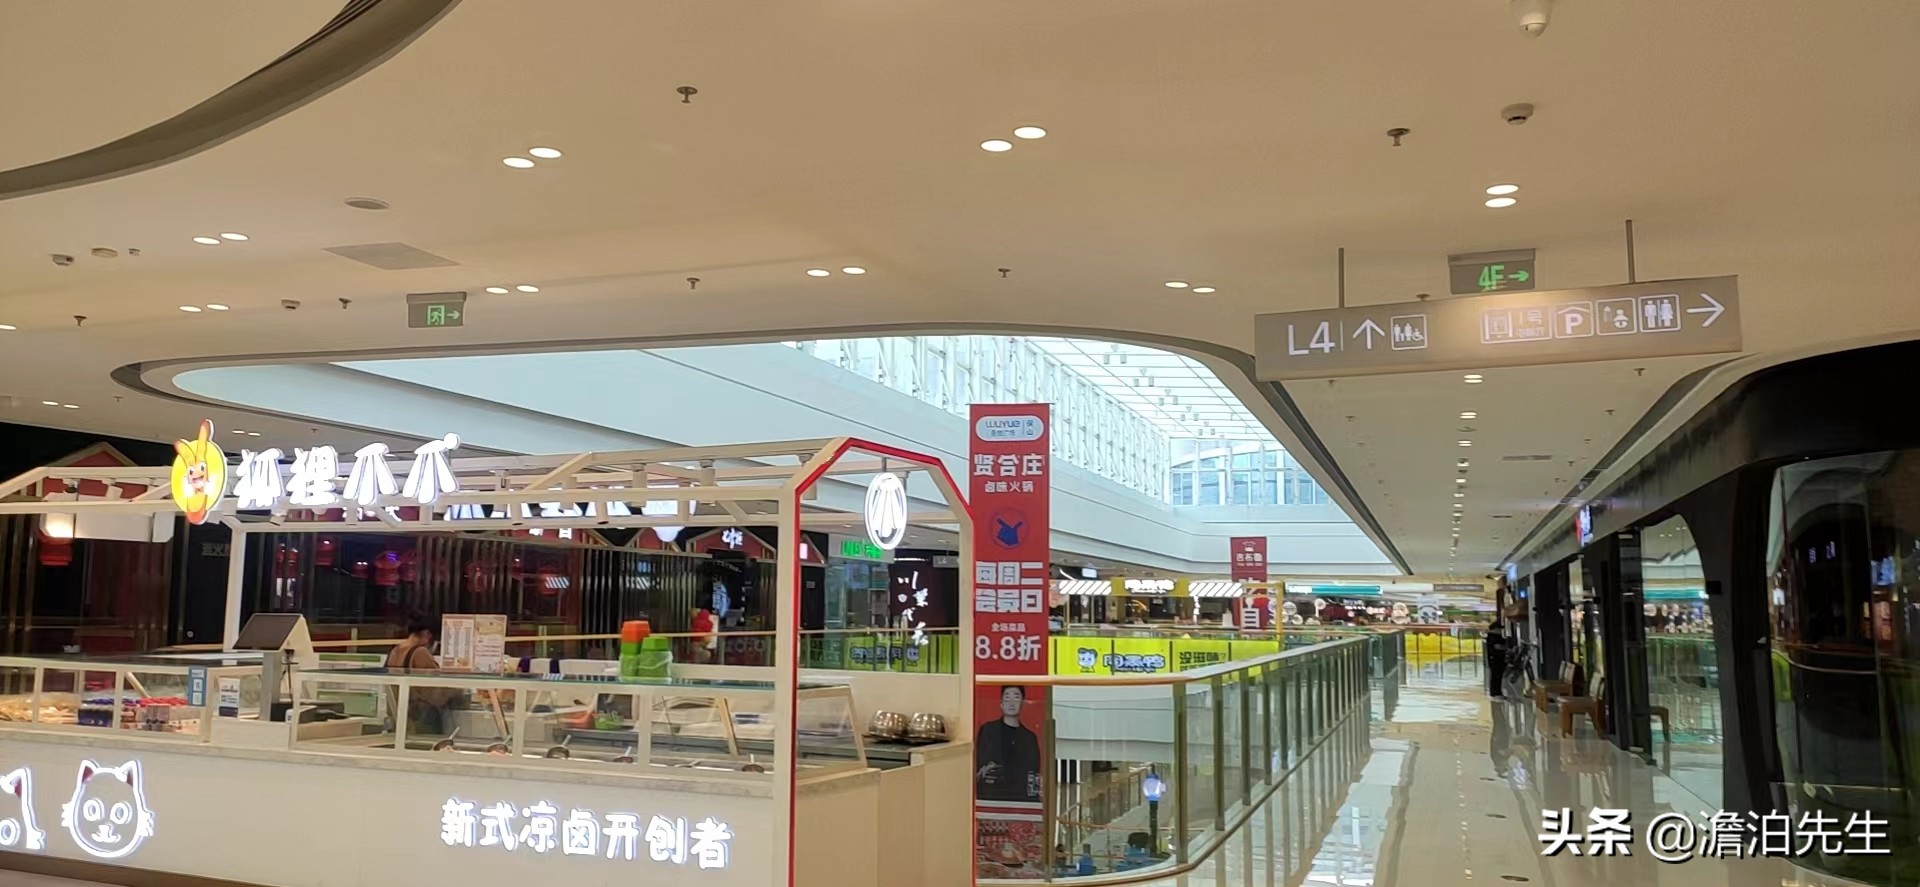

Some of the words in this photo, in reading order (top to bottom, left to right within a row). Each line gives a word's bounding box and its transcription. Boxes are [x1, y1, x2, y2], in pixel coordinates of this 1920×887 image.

[1478, 265, 1505, 290] 4F
[1288, 321, 1335, 355] L4
[233, 432, 460, 508] 狐狸爪爪
[973, 453, 1044, 476] 贤合庄
[984, 480, 1034, 493] 卤味火锅
[975, 561, 1043, 585] 每周二
[975, 588, 1043, 613] 会员日
[975, 634, 1042, 661] 8.8折
[440, 797, 734, 870] 新式凉卤开创者
